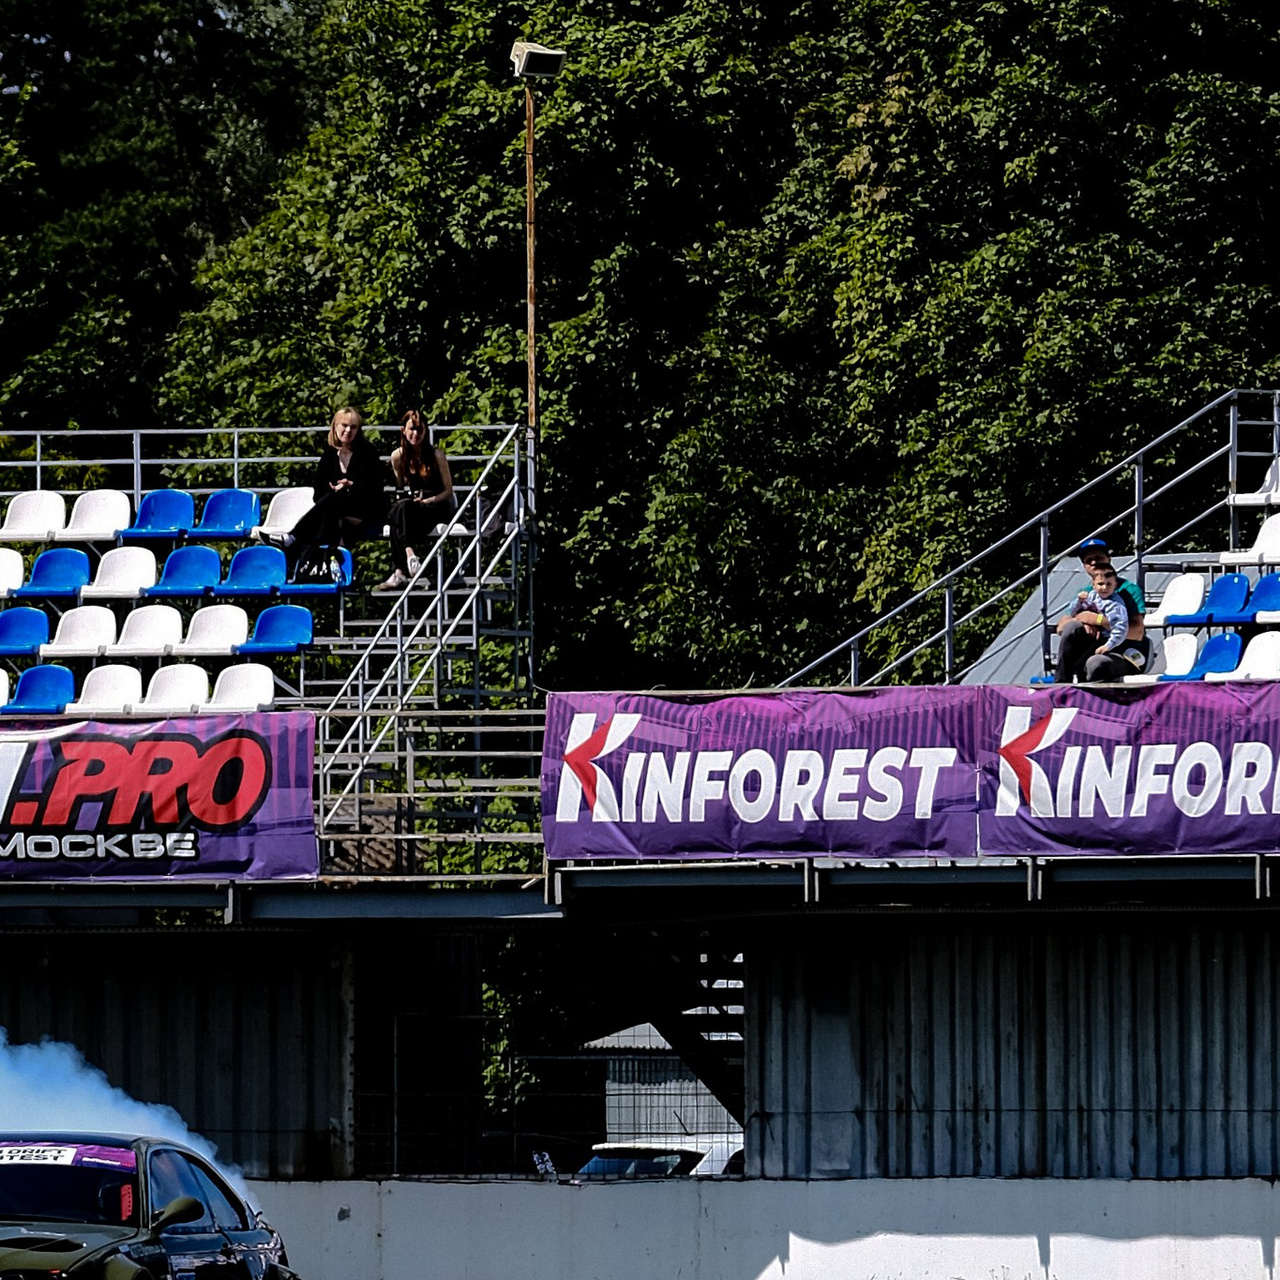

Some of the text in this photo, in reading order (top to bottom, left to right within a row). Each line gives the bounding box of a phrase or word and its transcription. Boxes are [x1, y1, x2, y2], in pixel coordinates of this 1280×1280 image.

[555, 712, 958, 824] KINFOREST
[993, 706, 1280, 818] KINFOR
[8, 1147, 67, 1155] DRIFT
